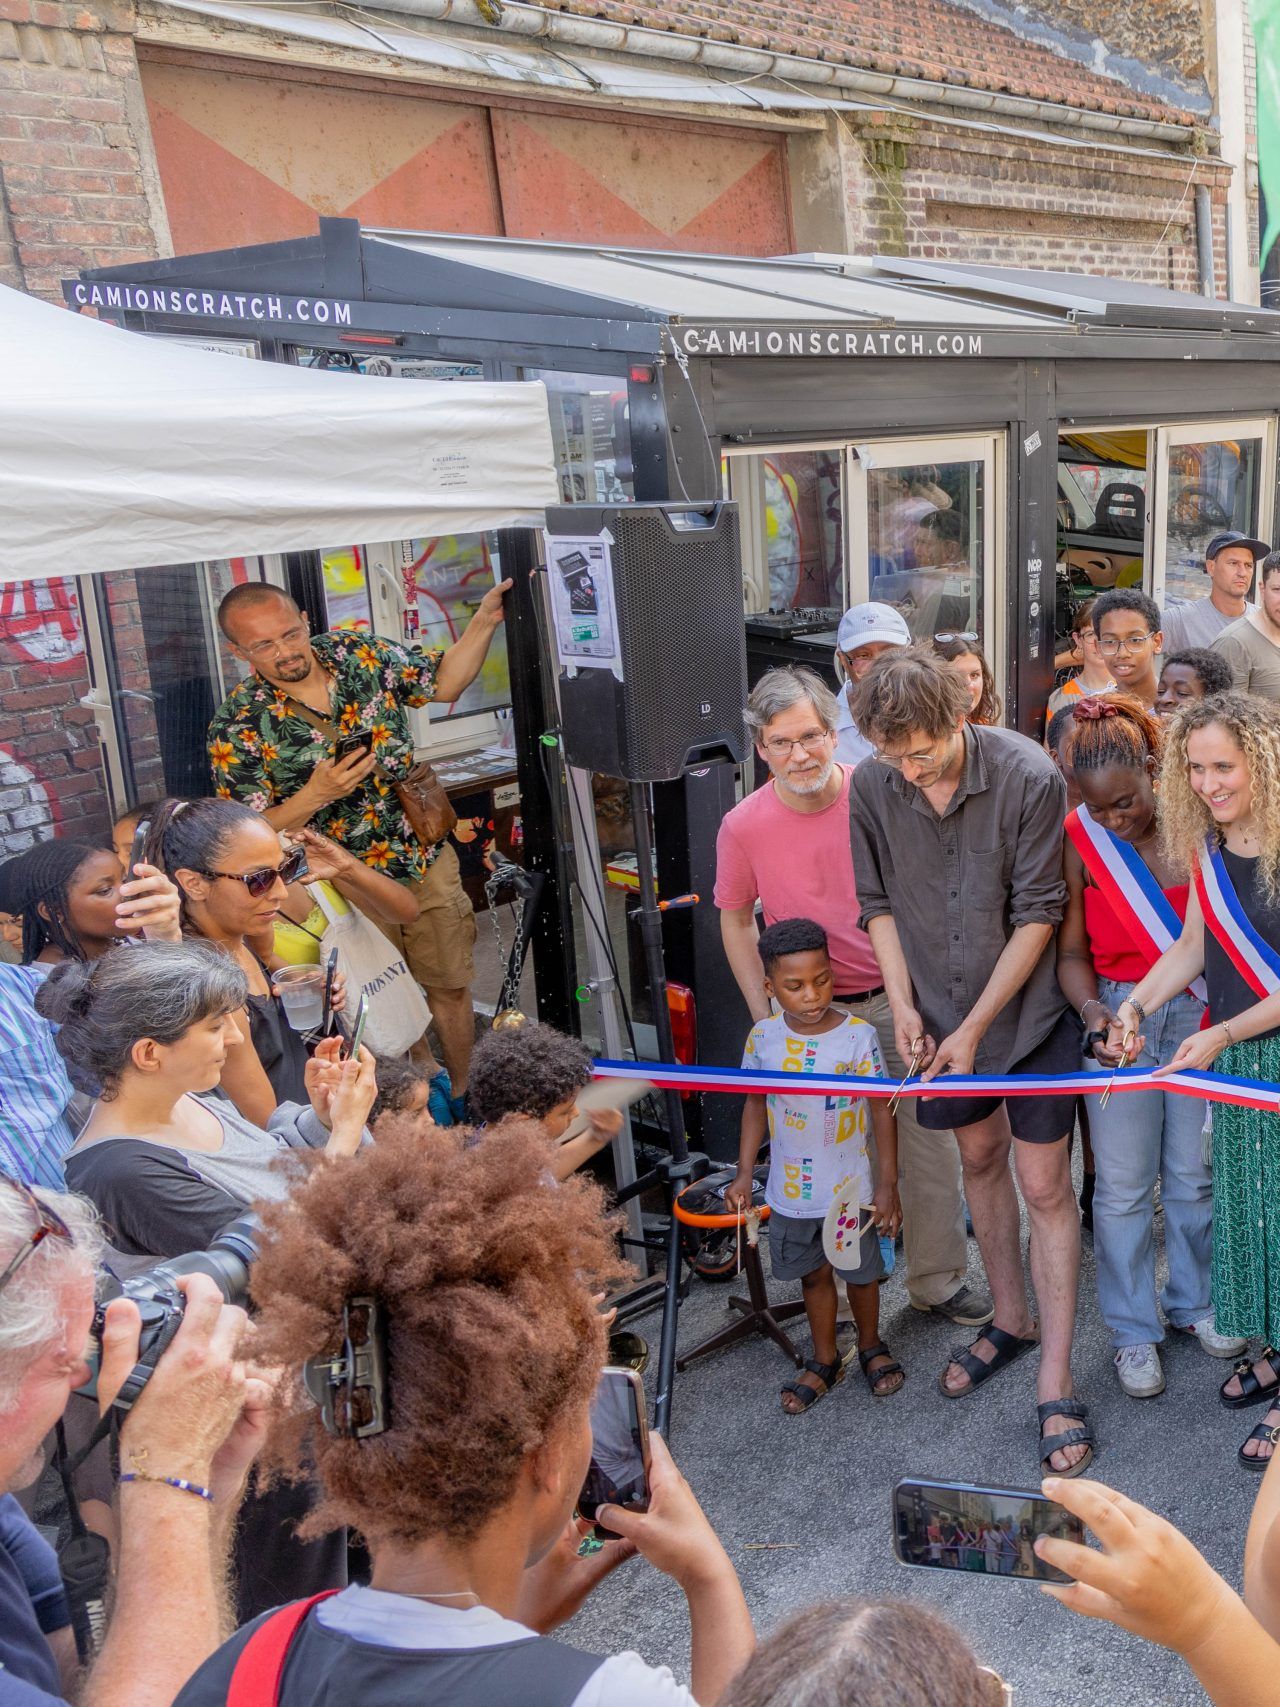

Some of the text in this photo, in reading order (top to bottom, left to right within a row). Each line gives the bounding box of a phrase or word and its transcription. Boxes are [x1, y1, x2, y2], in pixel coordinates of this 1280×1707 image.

[74, 284, 351, 325] CAMIONSCRATCH.COM
[683, 328, 983, 355] CAMIONSCRATCH.COM
[785, 1108, 808, 1120] LEARN
[785, 1117, 806, 1131] DO
[783, 1163, 801, 1199] DO
[802, 1158, 813, 1200] LEARN
